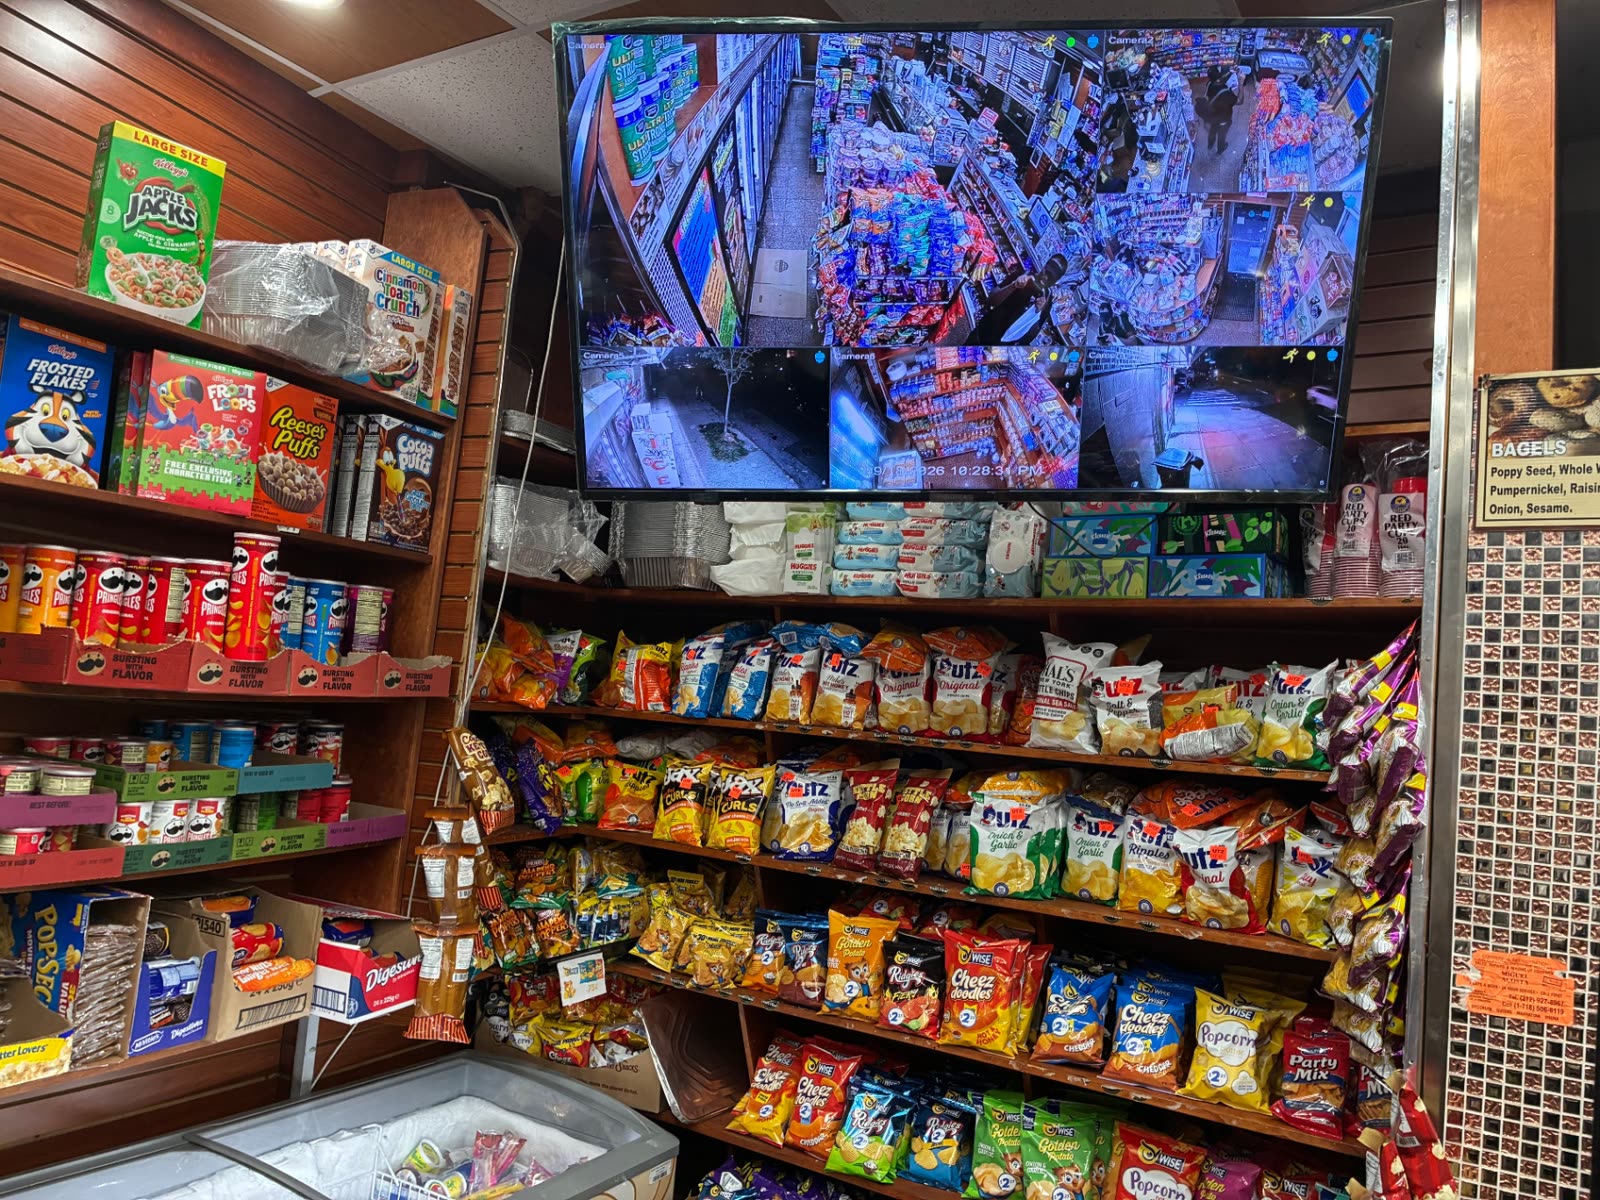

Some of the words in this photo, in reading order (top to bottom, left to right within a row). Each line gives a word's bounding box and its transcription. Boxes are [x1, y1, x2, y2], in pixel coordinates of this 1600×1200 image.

[133, 130, 177, 155] LARGE
[180, 149, 208, 167] SIZE
[142, 186, 185, 205] APPLE
[124, 194, 197, 229] JACKS
[390, 253, 415, 272] LARGE
[417, 265, 433, 280] SIZE
[376, 268, 424, 292] Cinnamon
[384, 284, 414, 302] Toast
[375, 293, 420, 318] Crunch
[27, 359, 95, 379] FROSTED
[30, 372, 88, 391] FLAKES
[207, 384, 256, 400] FROOT
[212, 397, 256, 413] LOOPS
[270, 406, 328, 441] Reese's
[273, 429, 320, 459] Puffs
[1492, 440, 1567, 457] BAGELS
[164, 467, 211, 481] CHARACTER
[212, 475, 233, 484] ITEM
[165, 460, 188, 470] FREE
[189, 464, 233, 477] EXCLUSIVE
[1018, 466, 1043, 476] PM
[1490, 466, 1523, 479] Poppy
[1525, 465, 1556, 477] Seed,
[1559, 463, 1592, 475] Whole
[1490, 483, 1567, 498] Pumpernickel,
[1345, 502, 1364, 511] RED
[1489, 504, 1523, 516] Onion,
[1526, 503, 1573, 514] Sesame.
[1341, 517, 1364, 526] CUPS
[1390, 514, 1412, 522] RED
[1384, 521, 1419, 531] PARTY
[1397, 537, 1408, 545] 20
[790, 563, 817, 571] HUGGIES
[96, 590, 123, 606] PRINGL
[112, 654, 157, 665] BURSTING
[112, 670, 153, 681] FLAVOR
[229, 665, 268, 675] BURSTING
[322, 670, 354, 678] BURSTING
[228, 678, 264, 689] FLAVOR
[322, 682, 352, 691] FLAVOR
[883, 679, 920, 693] Original
[940, 680, 980, 694] Original
[1037, 685, 1053, 695] TTLE
[1054, 689, 1075, 700] CHIPS
[1106, 701, 1126, 709] Salt
[1271, 699, 1294, 709] Onion
[181, 783, 208, 792] FLAVOR
[665, 791, 697, 805] CURLS
[721, 801, 758, 813] CURLS
[988, 832, 1014, 841] Onion
[1016, 830, 1023, 840] &
[1075, 838, 1102, 847] Onion
[1102, 838, 1109, 847] &
[280, 842, 302, 851] FLAVOR
[990, 840, 1018, 852] Garlic
[1078, 846, 1104, 858] Garlic
[1128, 843, 1170, 860] Ripples
[854, 928, 870, 936] WISE
[836, 937, 872, 950] Golden
[971, 953, 993, 964] WISE
[951, 969, 995, 987] Cheez
[951, 985, 993, 1000] doodles
[1148, 997, 1167, 1005] WISE
[1122, 1004, 1170, 1024] Cheez
[1228, 1007, 1254, 1019] WISE
[977, 1029, 989, 1039] HOT
[1121, 1021, 1168, 1035] doodles
[976, 1031, 1002, 1046] HONEY
[1201, 1026, 1256, 1048] Popcorn
[0, 1048, 15, 1060] tter
[1138, 1060, 1172, 1074] CHEDDAR
[1289, 1054, 1337, 1069] Party
[754, 1068, 790, 1083] Cheez
[818, 1064, 834, 1075] WISE
[1295, 1068, 1329, 1081] Mix
[797, 1077, 832, 1097] Cheez
[1006, 1113, 1021, 1122] WISE
[1058, 1127, 1074, 1136] WISE
[1039, 1138, 1080, 1154] Golden
[1048, 1152, 1074, 1161] Potato
[1158, 1154, 1184, 1171] WISE
[1210, 1165, 1226, 1177] WISE
[1130, 1171, 1185, 1200] Popcorn
[1283, 1180, 1307, 1194] WISE
